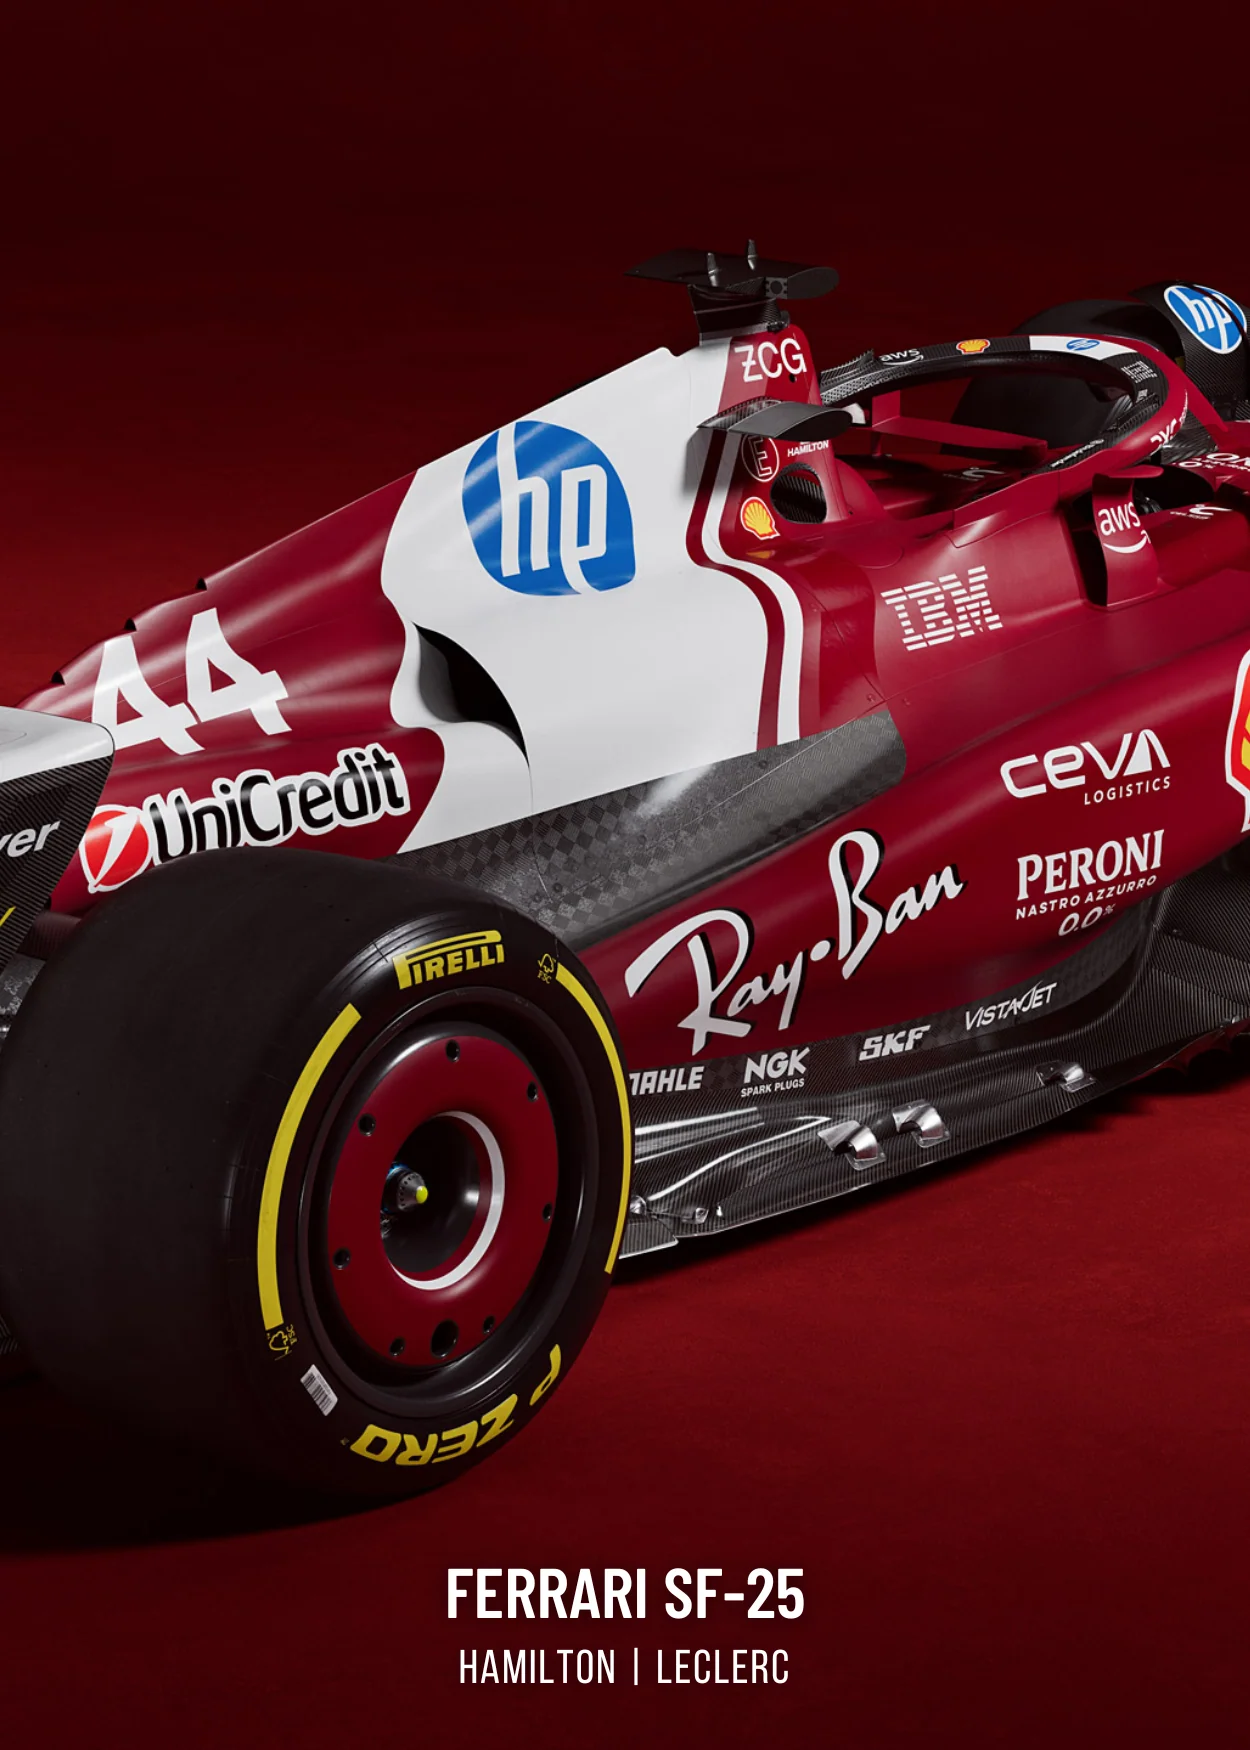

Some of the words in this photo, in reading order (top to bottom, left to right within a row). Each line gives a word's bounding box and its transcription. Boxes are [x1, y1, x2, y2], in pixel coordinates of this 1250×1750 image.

[734, 337, 808, 383] ZCG
[787, 439, 830, 458] HAMILTON
[497, 421, 608, 594] hp
[1098, 501, 1142, 536] aws
[880, 565, 1003, 652] IBM
[92, 606, 293, 757] 44
[148, 747, 405, 865] UniCredit
[1084, 775, 1171, 806] LOGISTICS
[1016, 829, 1165, 901] PERONI
[1016, 894, 1080, 920] NASTRO
[1084, 875, 1157, 904] AZZURRO
[392, 929, 505, 990] PIRELLI
[743, 1047, 810, 1084] NGK
[858, 1024, 931, 1061] SKF
[740, 1083, 772, 1098] SPARK
[774, 1077, 805, 1092] PLUGS
[529, 1343, 562, 1406] P
[350, 1393, 518, 1466] ZERO
